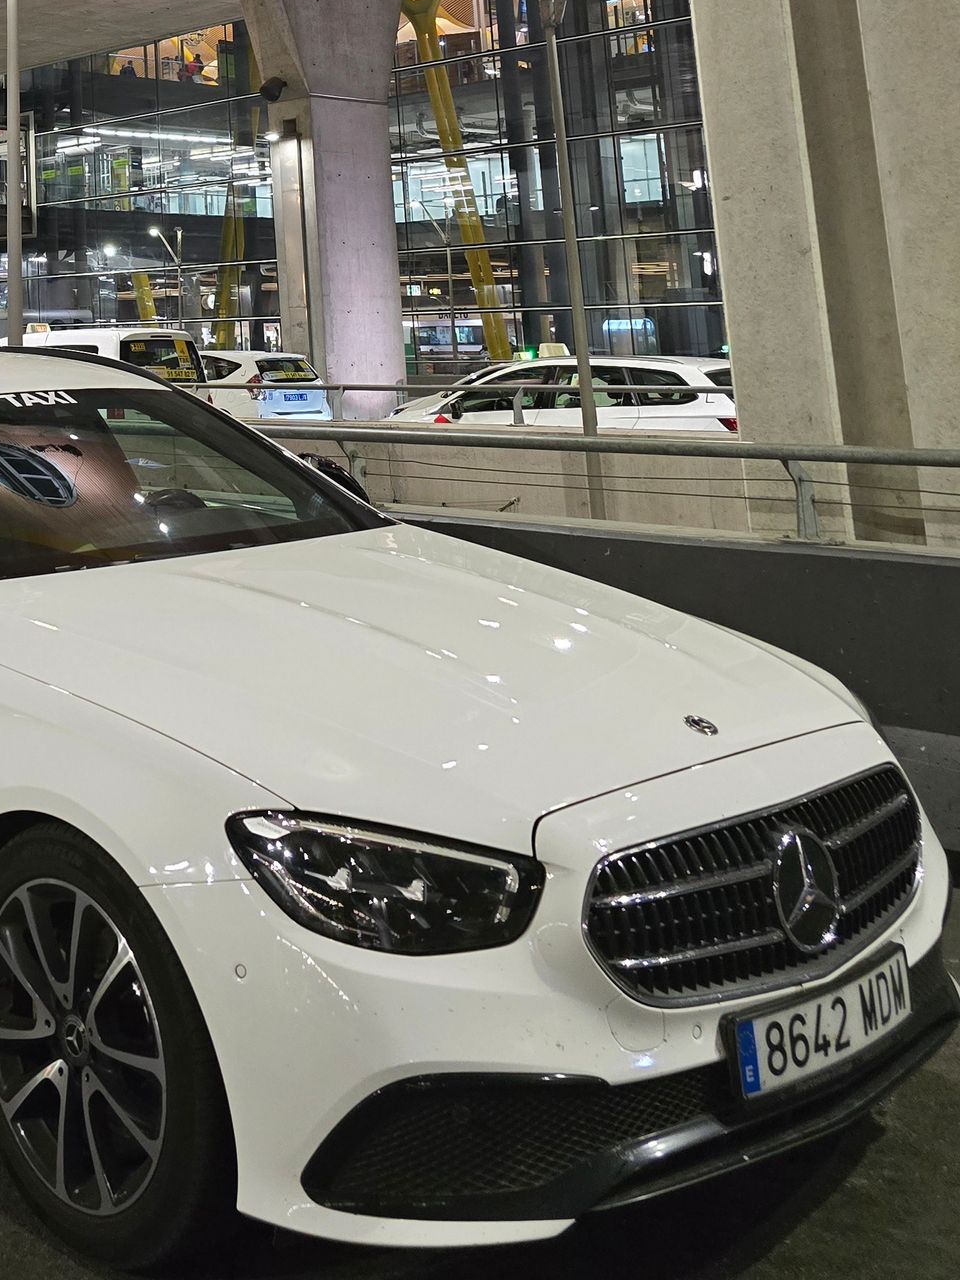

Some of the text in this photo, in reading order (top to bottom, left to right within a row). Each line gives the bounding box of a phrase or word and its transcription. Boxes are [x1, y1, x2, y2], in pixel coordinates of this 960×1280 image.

[745, 959, 905, 1082] E 8642 MDM
